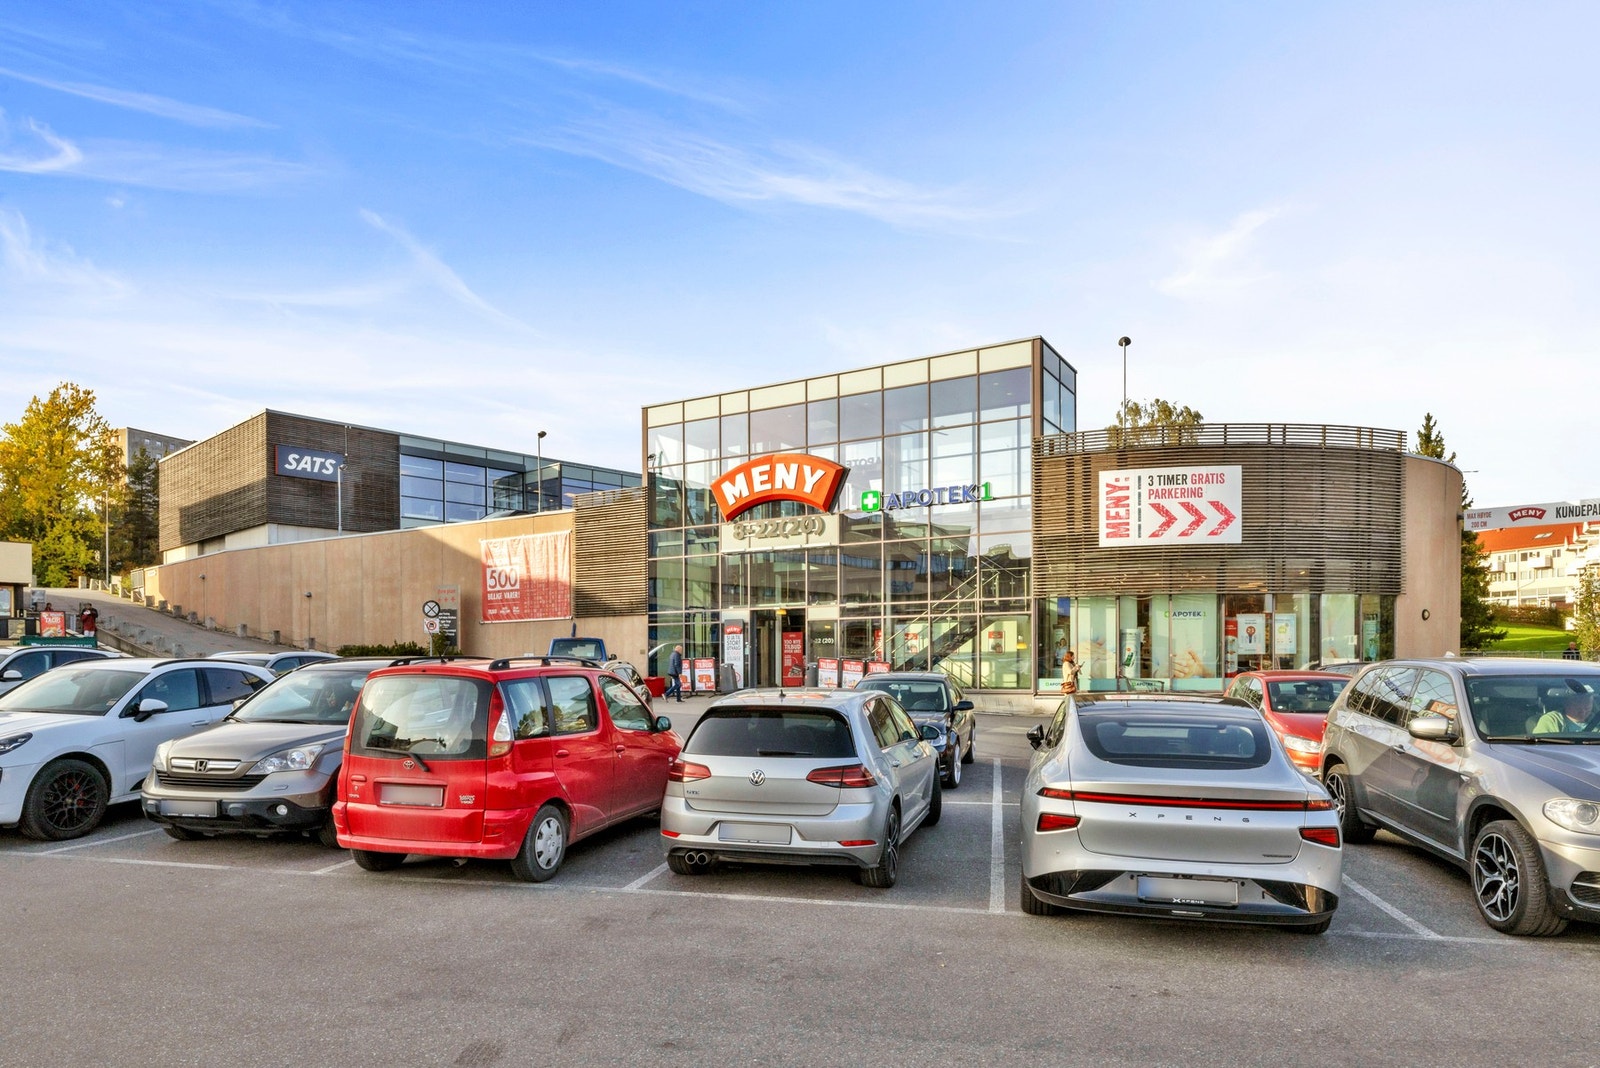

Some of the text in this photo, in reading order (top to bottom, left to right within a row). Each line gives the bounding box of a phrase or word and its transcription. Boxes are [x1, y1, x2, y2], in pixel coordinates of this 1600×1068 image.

[284, 453, 336, 475] SATS
[721, 463, 826, 506] MENY
[1148, 472, 1226, 487] 3 TIMER GRATIS
[886, 481, 994, 510] APOTEK 1
[1148, 487, 1203, 500] PARKERING
[1512, 509, 1543, 519] MENY
[488, 568, 518, 590] 500
[1129, 811, 1250, 823] XPENG
